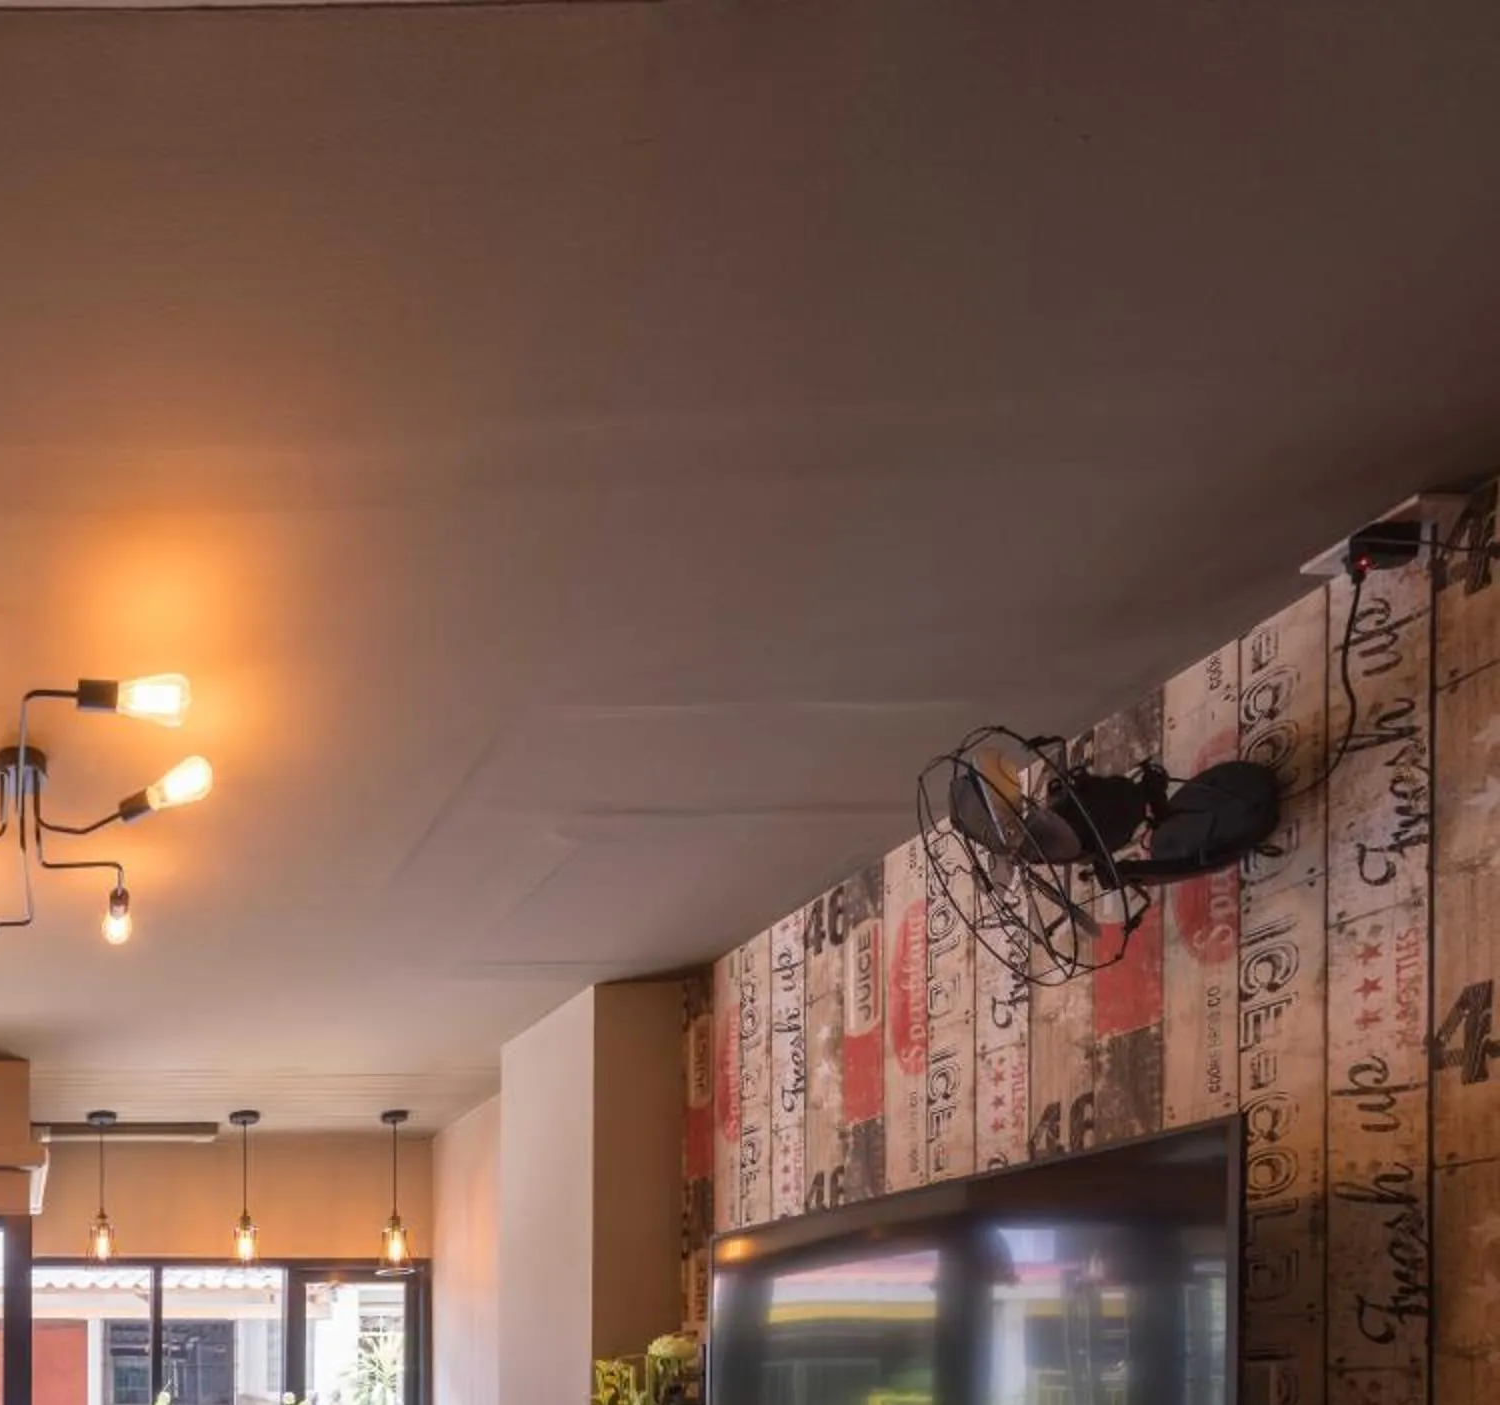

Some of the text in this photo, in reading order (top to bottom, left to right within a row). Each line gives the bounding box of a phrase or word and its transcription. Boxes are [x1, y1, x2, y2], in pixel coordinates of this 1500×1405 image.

[1334, 597, 1430, 887] Fresh up
[802, 884, 844, 956] 46
[856, 930, 873, 1022] JUICE
[771, 947, 807, 1113] Fresh up
[1329, 1054, 1429, 1344] Fresh up
